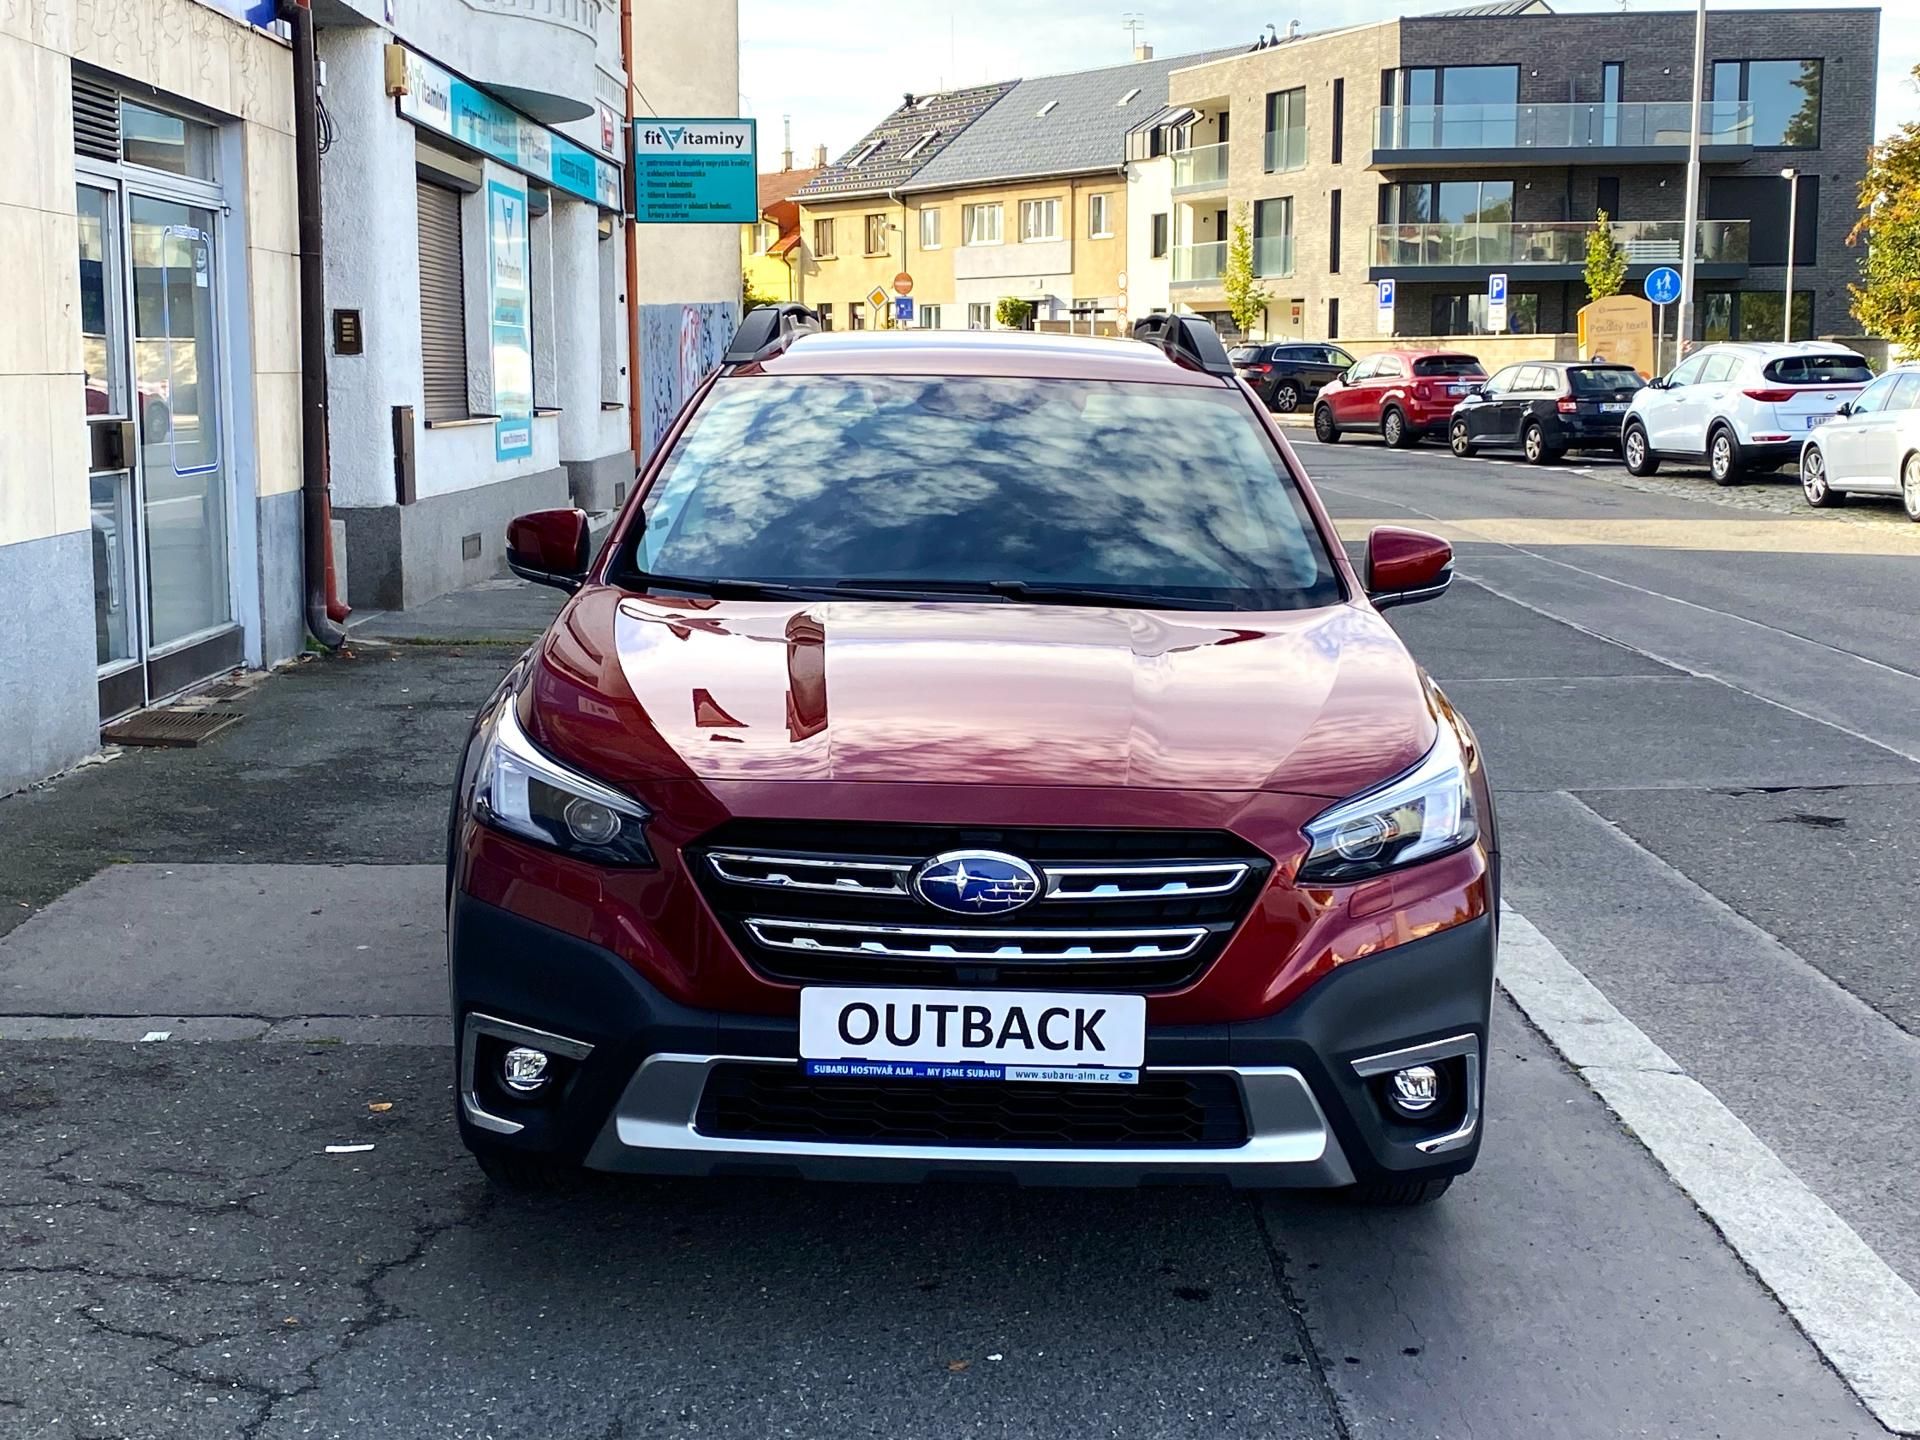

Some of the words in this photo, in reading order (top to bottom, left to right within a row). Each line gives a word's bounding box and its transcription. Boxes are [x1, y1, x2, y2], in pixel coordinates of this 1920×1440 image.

[644, 126, 744, 151] fitVitaminy
[1382, 284, 1391, 302] P
[1493, 279, 1503, 297] P
[837, 1002, 1106, 1051] OUTBACK
[814, 1065, 848, 1074] SUBARU
[850, 1065, 893, 1075] HOSTIVAŘ
[895, 1067, 914, 1076] ALM
[927, 1067, 940, 1076] MY
[943, 1068, 964, 1077] JSME
[966, 1069, 1001, 1077] SUBARU
[1015, 1070, 1110, 1080] www.subaru-alm.cz
